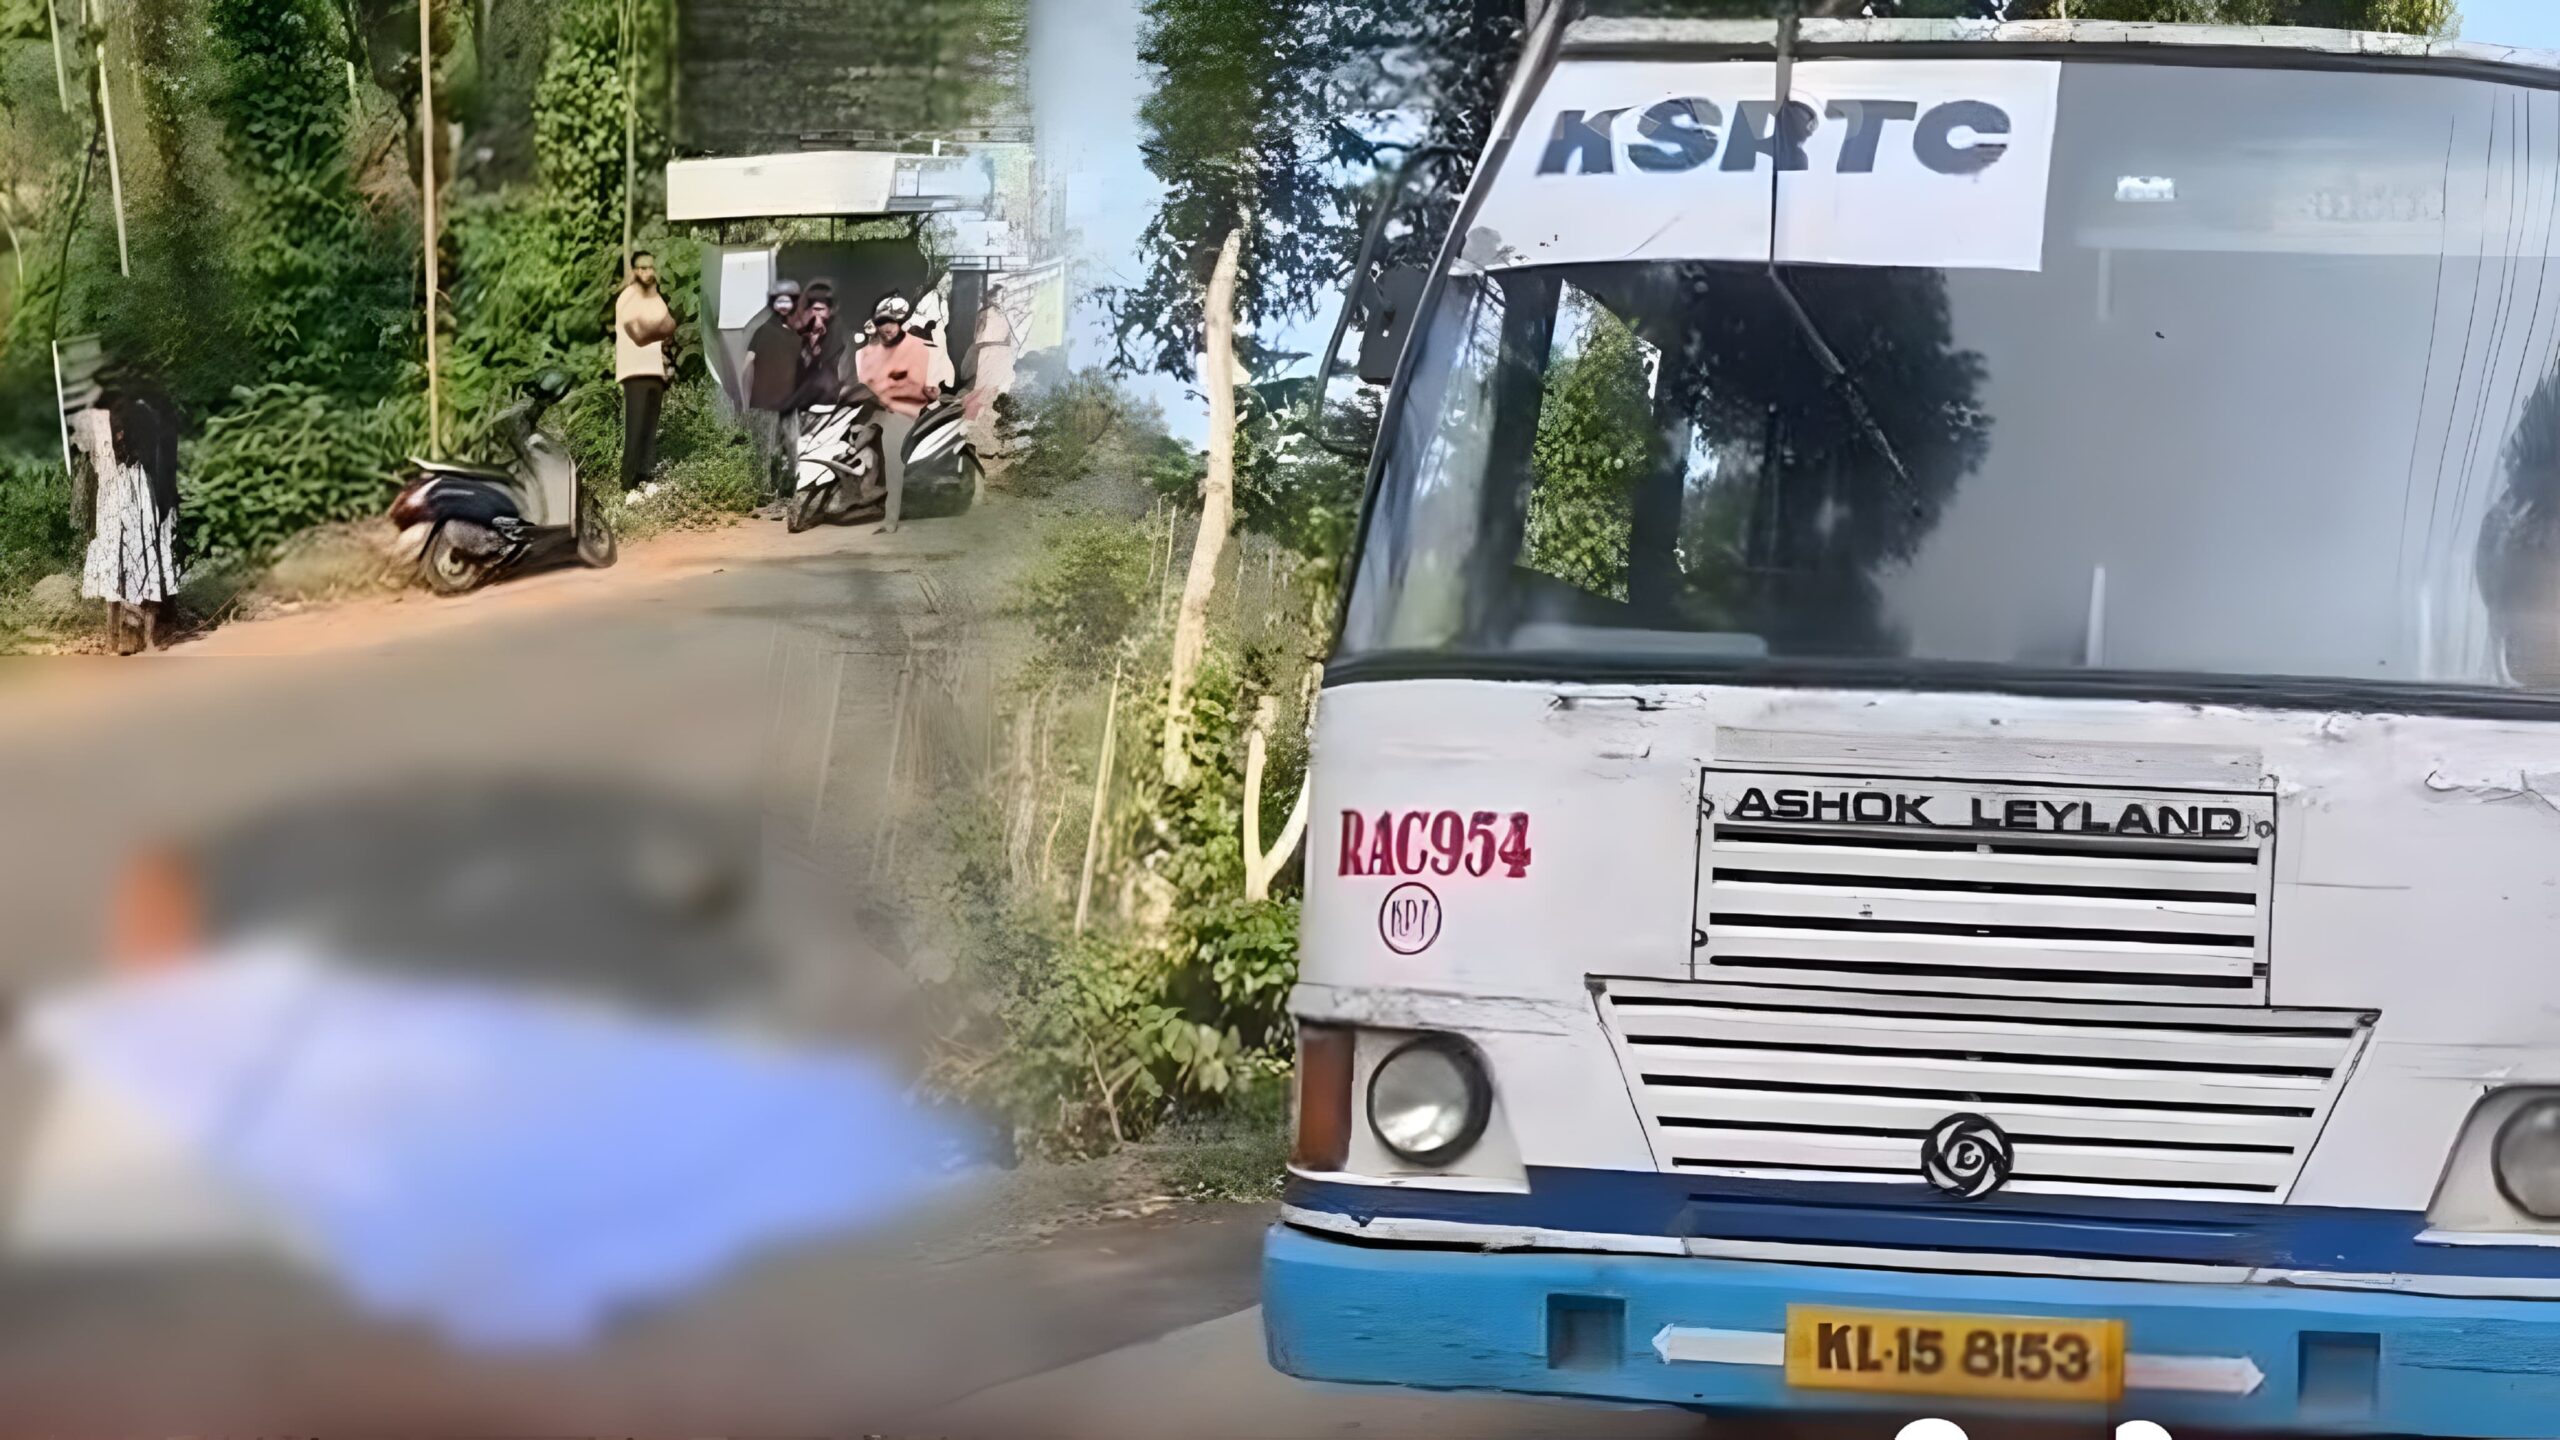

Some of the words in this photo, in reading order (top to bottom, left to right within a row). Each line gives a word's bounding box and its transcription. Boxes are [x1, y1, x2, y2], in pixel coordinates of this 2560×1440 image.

[1537, 97, 2012, 175] KSRTC
[1734, 786, 1934, 826] ASHOK
[1970, 796, 2244, 838] LEYLAND
[1338, 810, 1532, 878] RAC954
[1961, 1329, 2092, 1382] 8153
